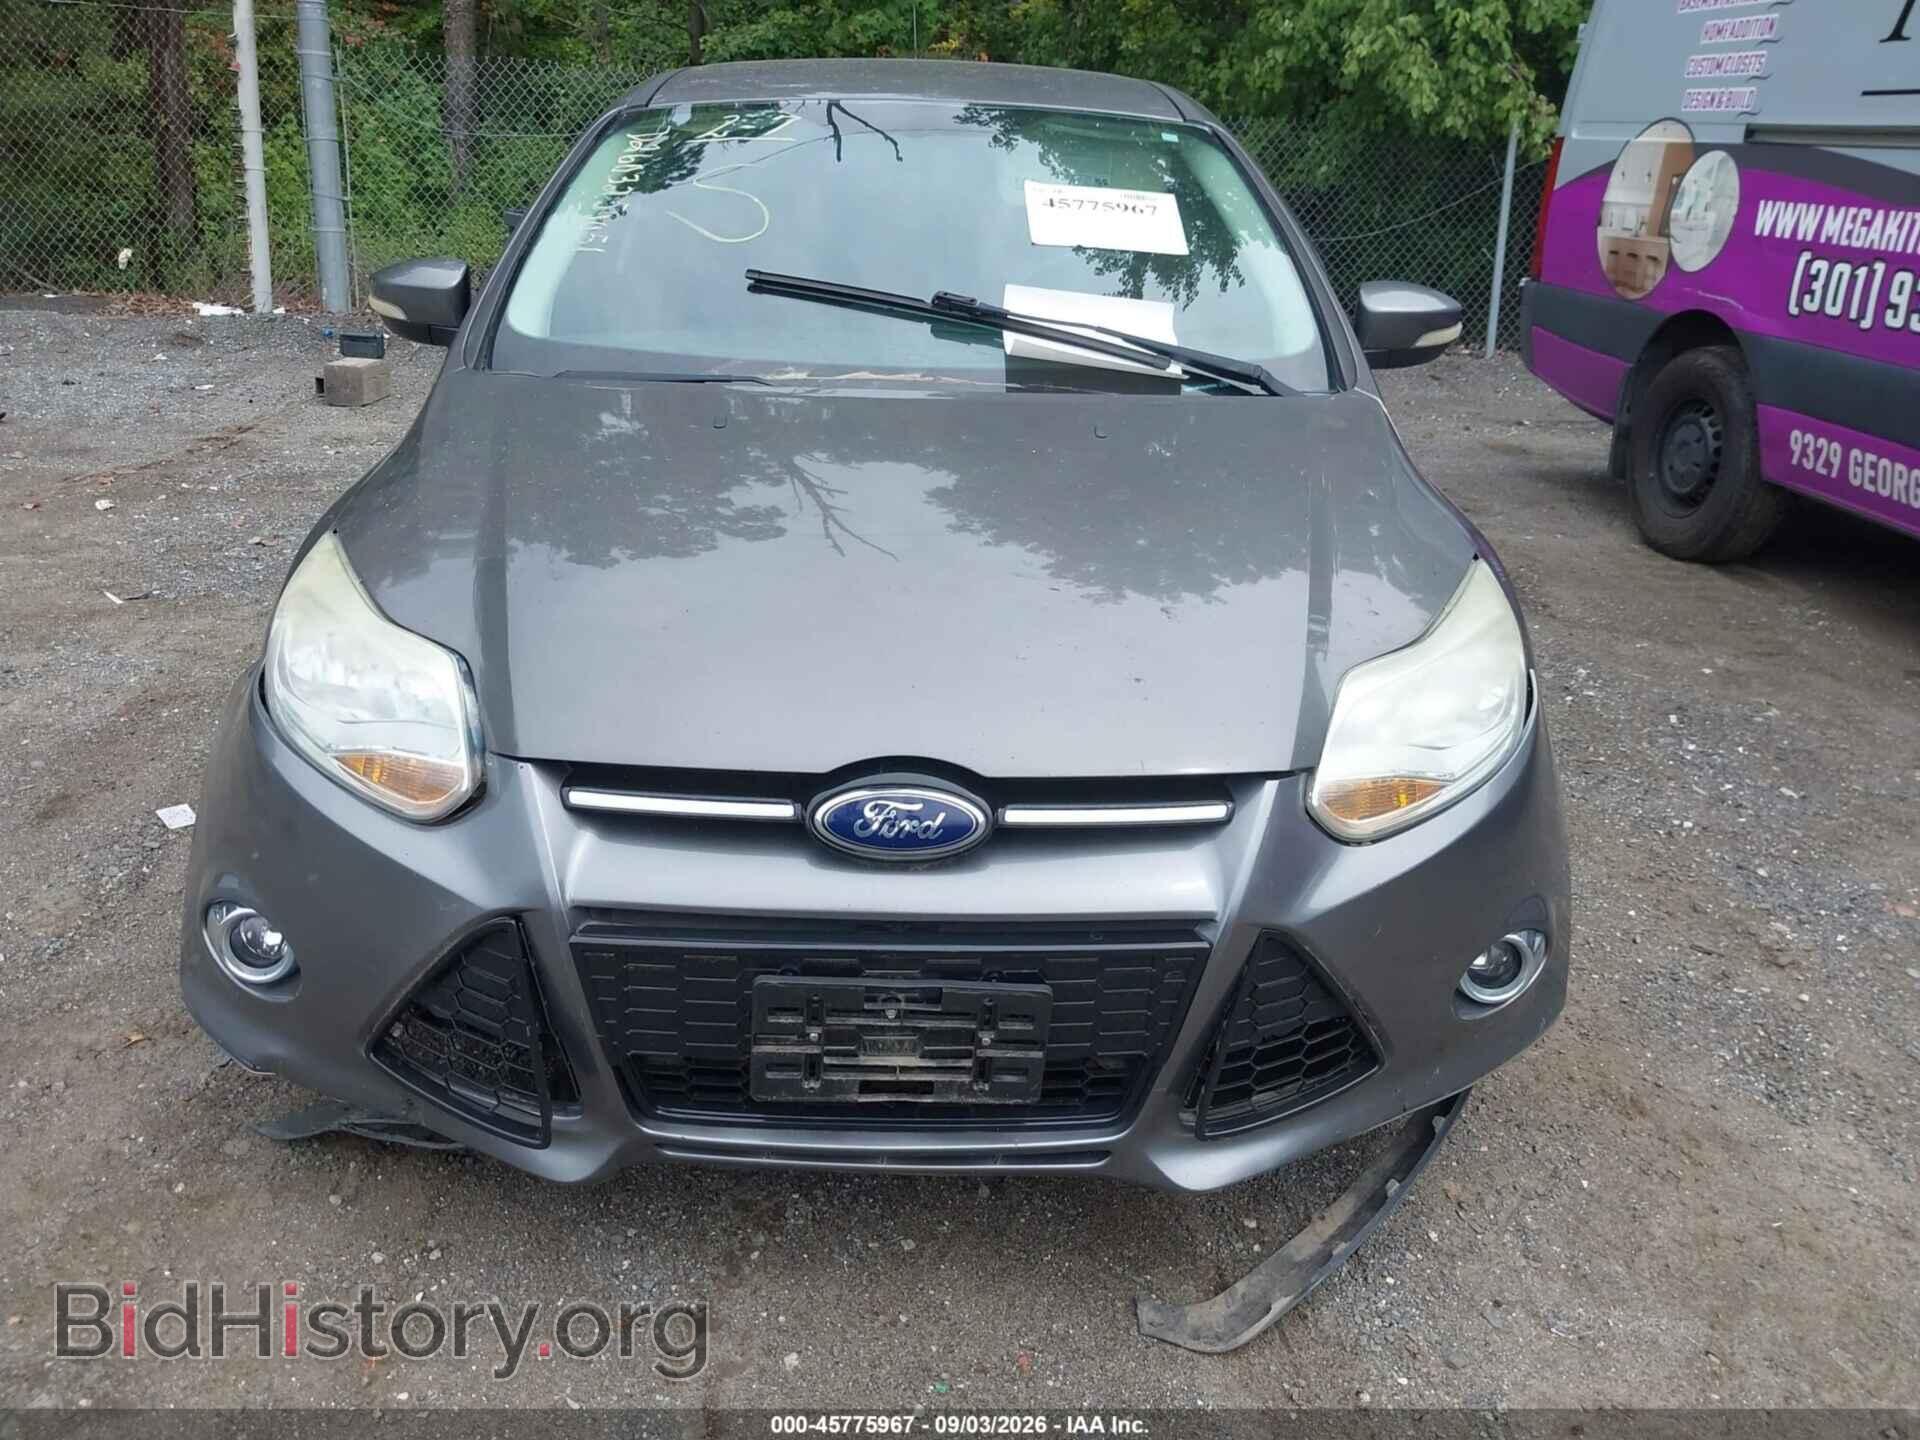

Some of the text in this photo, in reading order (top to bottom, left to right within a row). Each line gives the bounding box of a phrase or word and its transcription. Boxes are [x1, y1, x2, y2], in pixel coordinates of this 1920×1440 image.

[1686, 51, 1767, 77] CUSTOM CLOSETS
[1681, 90, 1715, 111] DESIGN
[1726, 88, 1756, 110] BUILD
[1788, 250, 1886, 330] (301)
[1790, 429, 1842, 478] 9329
[853, 799, 947, 840] Ford
